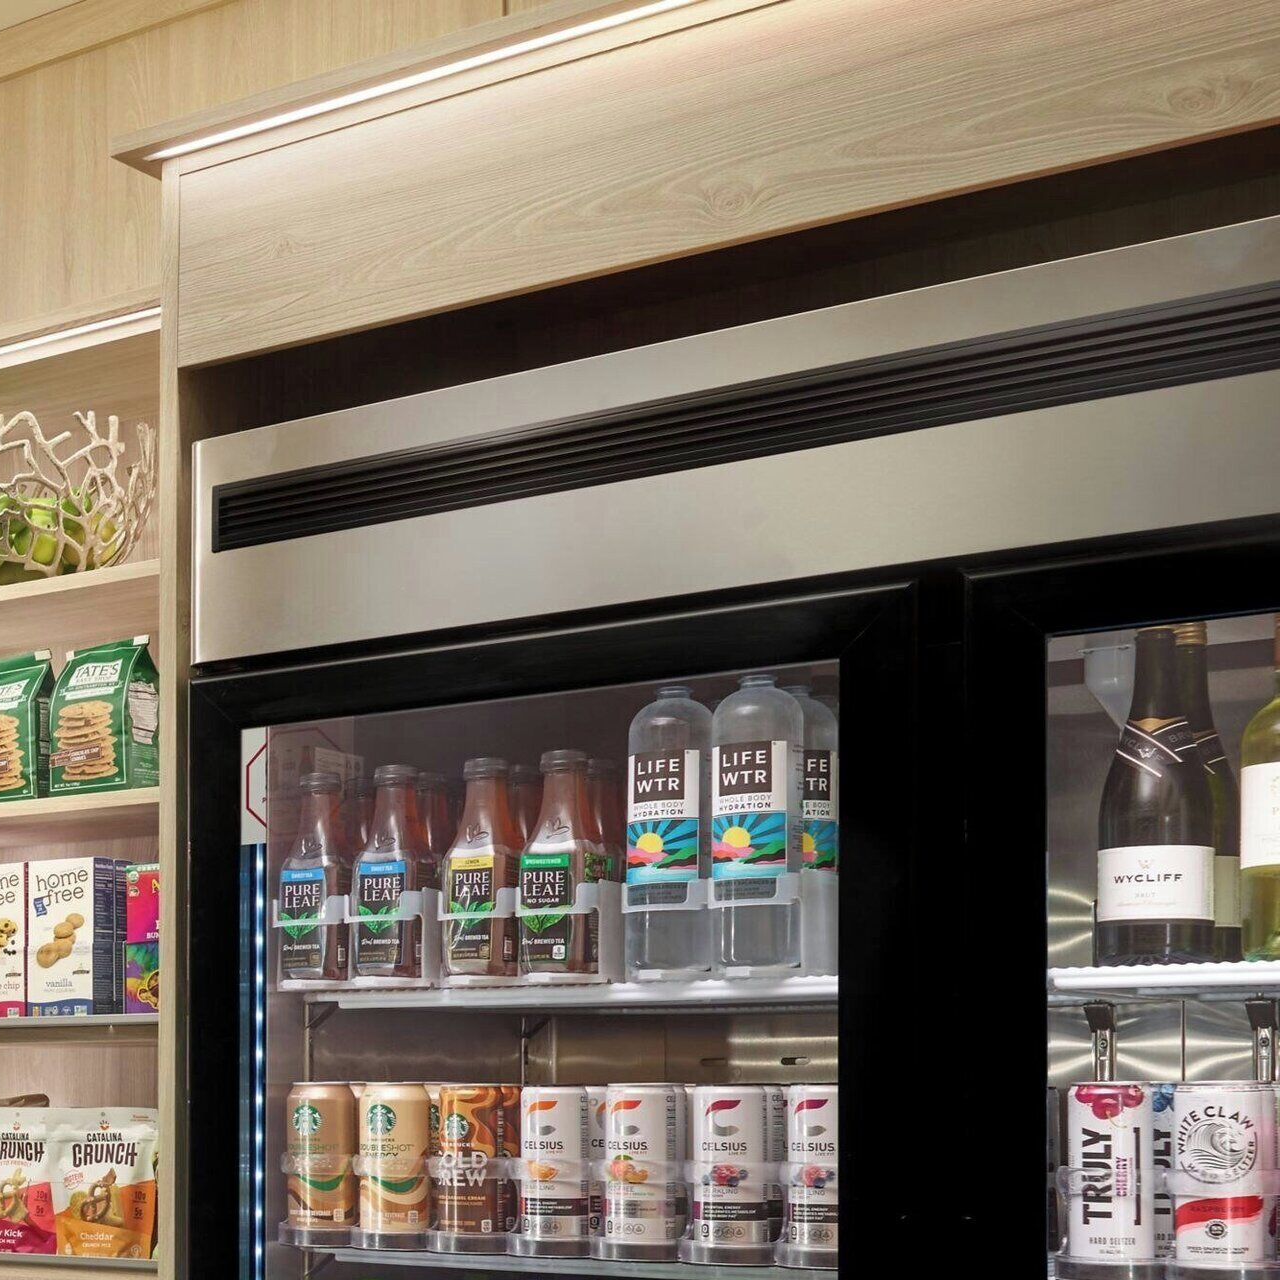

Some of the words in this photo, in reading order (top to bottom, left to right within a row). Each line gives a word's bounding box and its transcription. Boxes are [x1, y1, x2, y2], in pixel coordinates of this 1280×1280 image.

[76, 663, 119, 678] TATE'S
[722, 750, 767, 767] LIFE
[638, 759, 680, 775] LIFE
[722, 770, 767, 787] WTR
[637, 778, 679, 793] WTR
[748, 794, 772, 802] BODY
[633, 808, 684, 817] HYDRATION
[719, 802, 771, 811] HYDRATION
[364, 877, 401, 889] PURE
[455, 872, 489, 884] PURE
[524, 871, 564, 883] PURE
[1113, 872, 1184, 884] WYCLIFF
[42, 885, 84, 907] free
[285, 884, 320, 896] PURE
[364, 889, 400, 901] LEAF
[455, 884, 489, 896] LEAF
[524, 884, 564, 896] LEAF
[285, 896, 319, 908] LEAF
[4, 982, 20, 991] chip
[45, 978, 73, 988] vanilla
[1177, 1111, 1202, 1155] WHITE
[1204, 1106, 1254, 1130] CLAW
[87, 1133, 122, 1142] CATALINA
[524, 1141, 563, 1150] CELSIUS
[608, 1142, 648, 1150] CELSIUS
[702, 1142, 747, 1151] CELSIUS
[792, 1142, 835, 1152] CELSIUS
[72, 1142, 137, 1167] CRUNCH
[1223, 1140, 1255, 1180] SELTZER
[1082, 1128, 1113, 1226] TRULY
[1116, 1156, 1128, 1197] CHERRY
[4, 1229, 23, 1237] Kick
[80, 1232, 114, 1240] Cheddar
[1089, 1237, 1107, 1245] HARD
[1110, 1237, 1136, 1246] SELTZER
